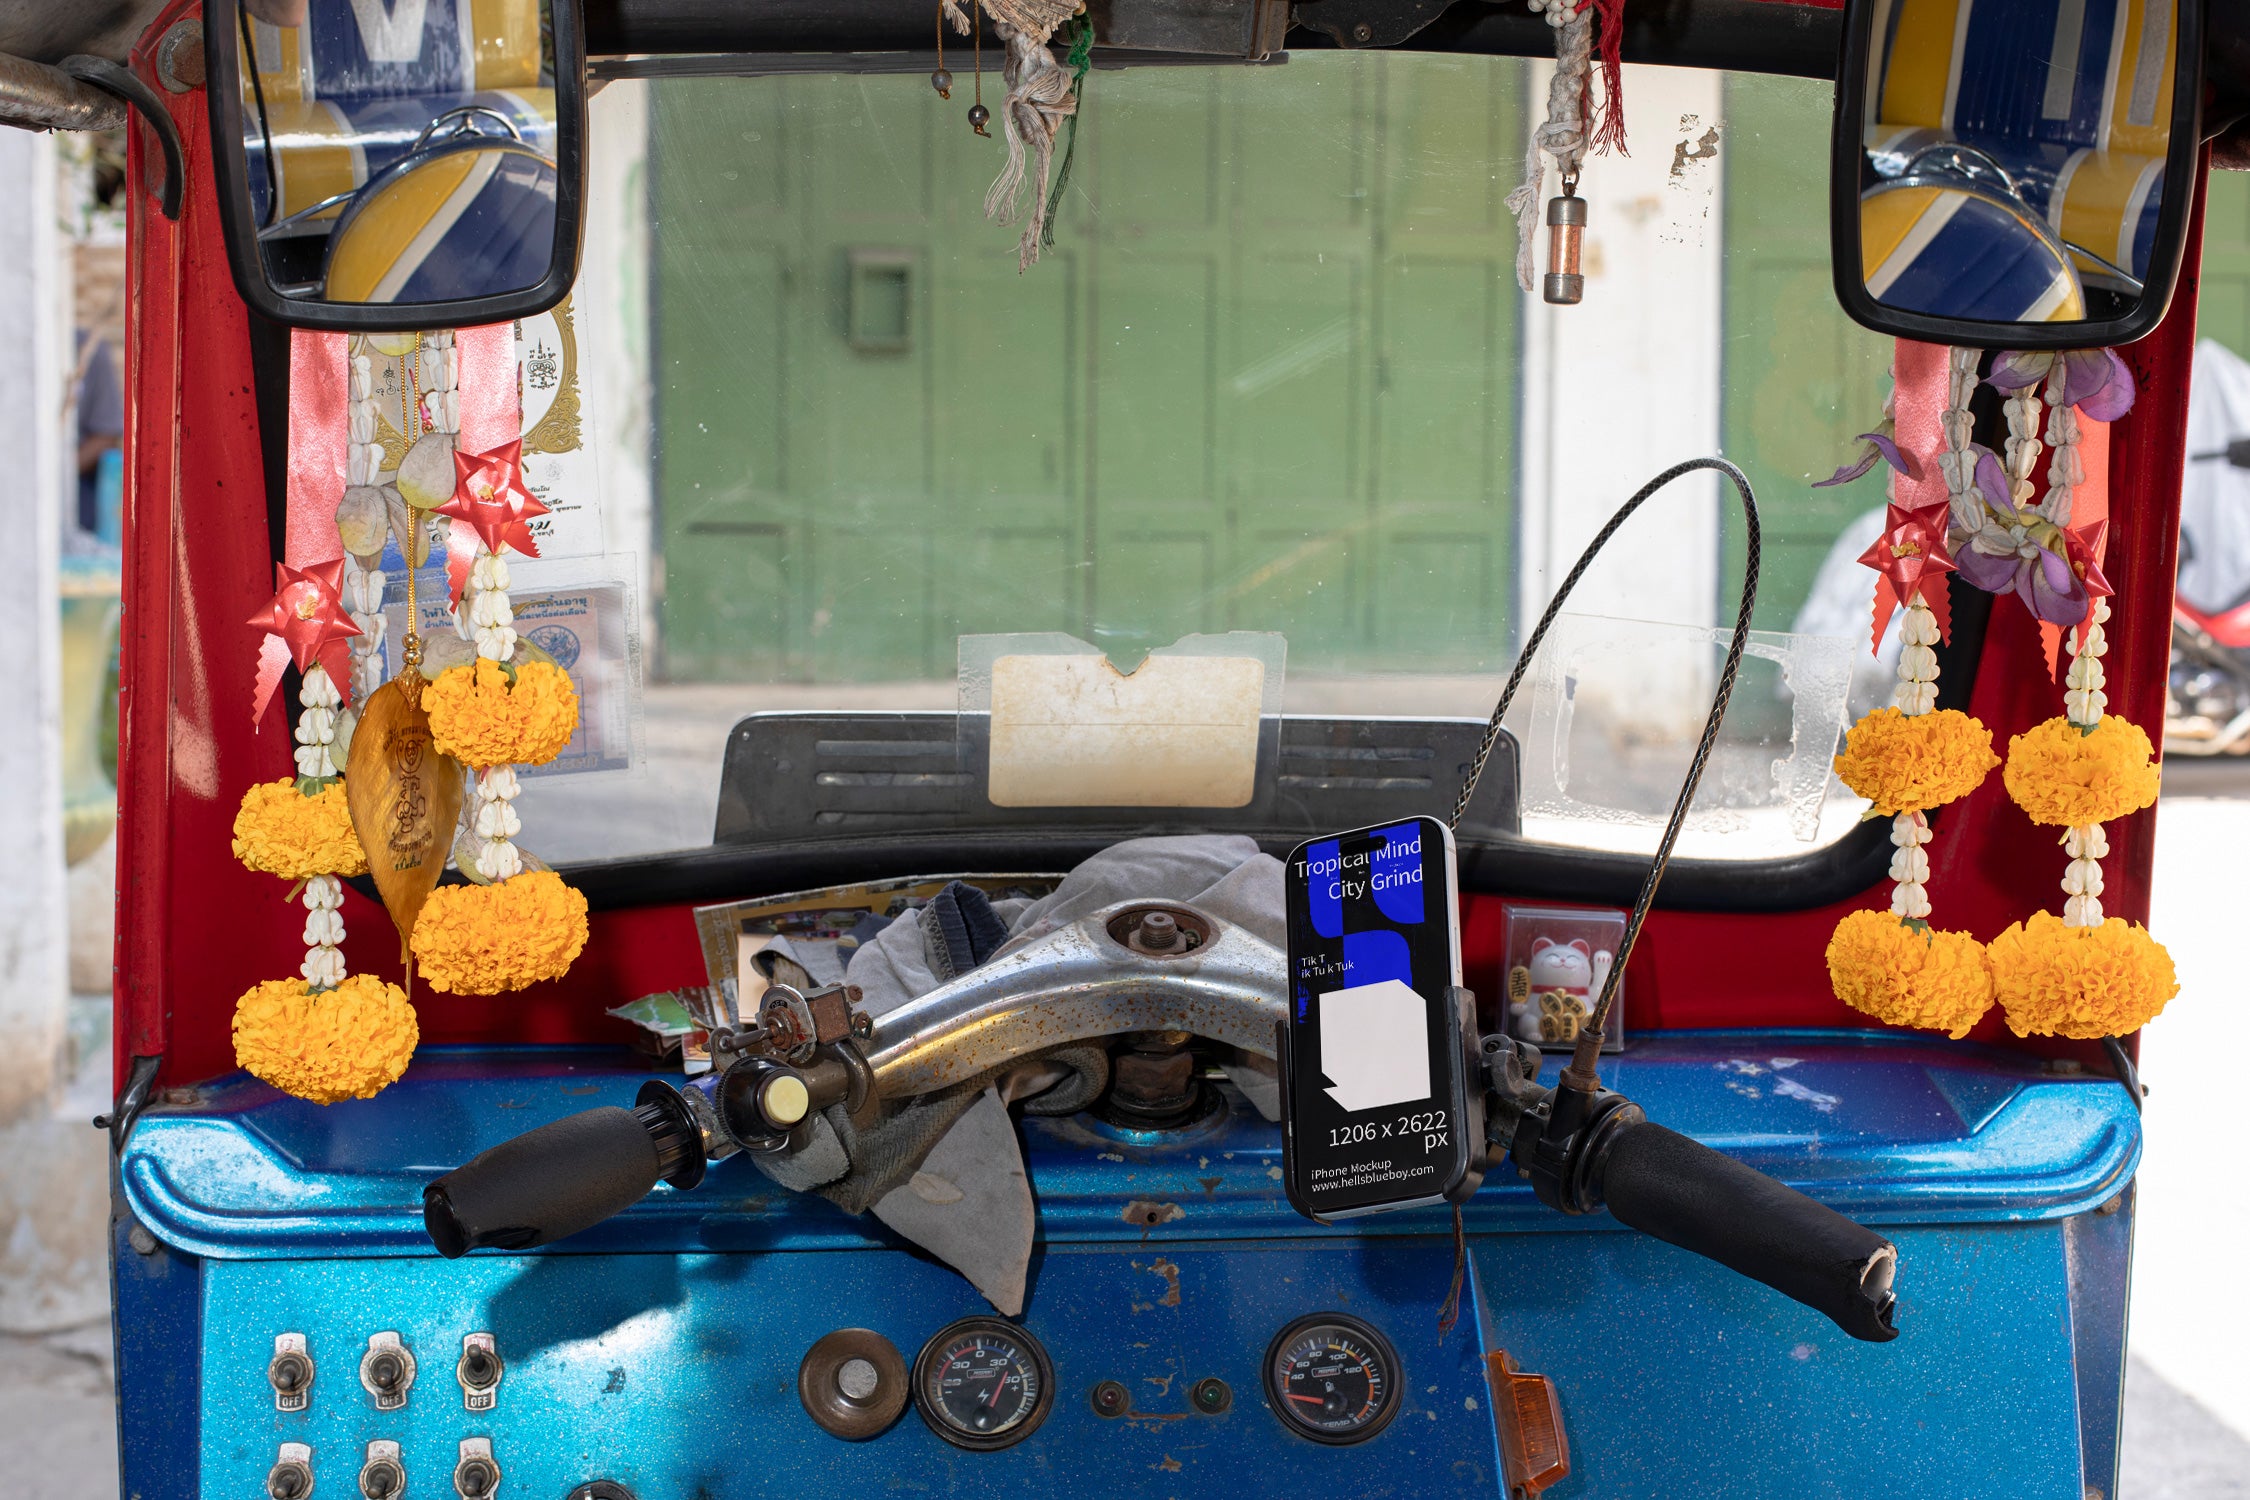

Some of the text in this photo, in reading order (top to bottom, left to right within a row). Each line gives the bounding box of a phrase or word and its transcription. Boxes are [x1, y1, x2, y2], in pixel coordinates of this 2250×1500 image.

[1294, 834, 1422, 878] Tropical Mind
[1328, 863, 1423, 900] City Grind
[1301, 953, 1326, 967] Tik T
[1301, 969, 1311, 979] ik
[1329, 1110, 1447, 1147] 1206 x 2622
[1425, 1131, 1449, 1154] px
[1311, 1159, 1392, 1180] iPhone Mockup
[1311, 1164, 1434, 1192] www.hellsblueboy.com
[975, 1350, 985, 1358] 0
[951, 1361, 970, 1369] 30
[989, 1358, 1008, 1367] 30
[281, 1396, 300, 1407] OFF
[381, 1394, 400, 1406] OFF
[470, 1396, 489, 1408] OFF
[1322, 1419, 1351, 1428] TEMP
